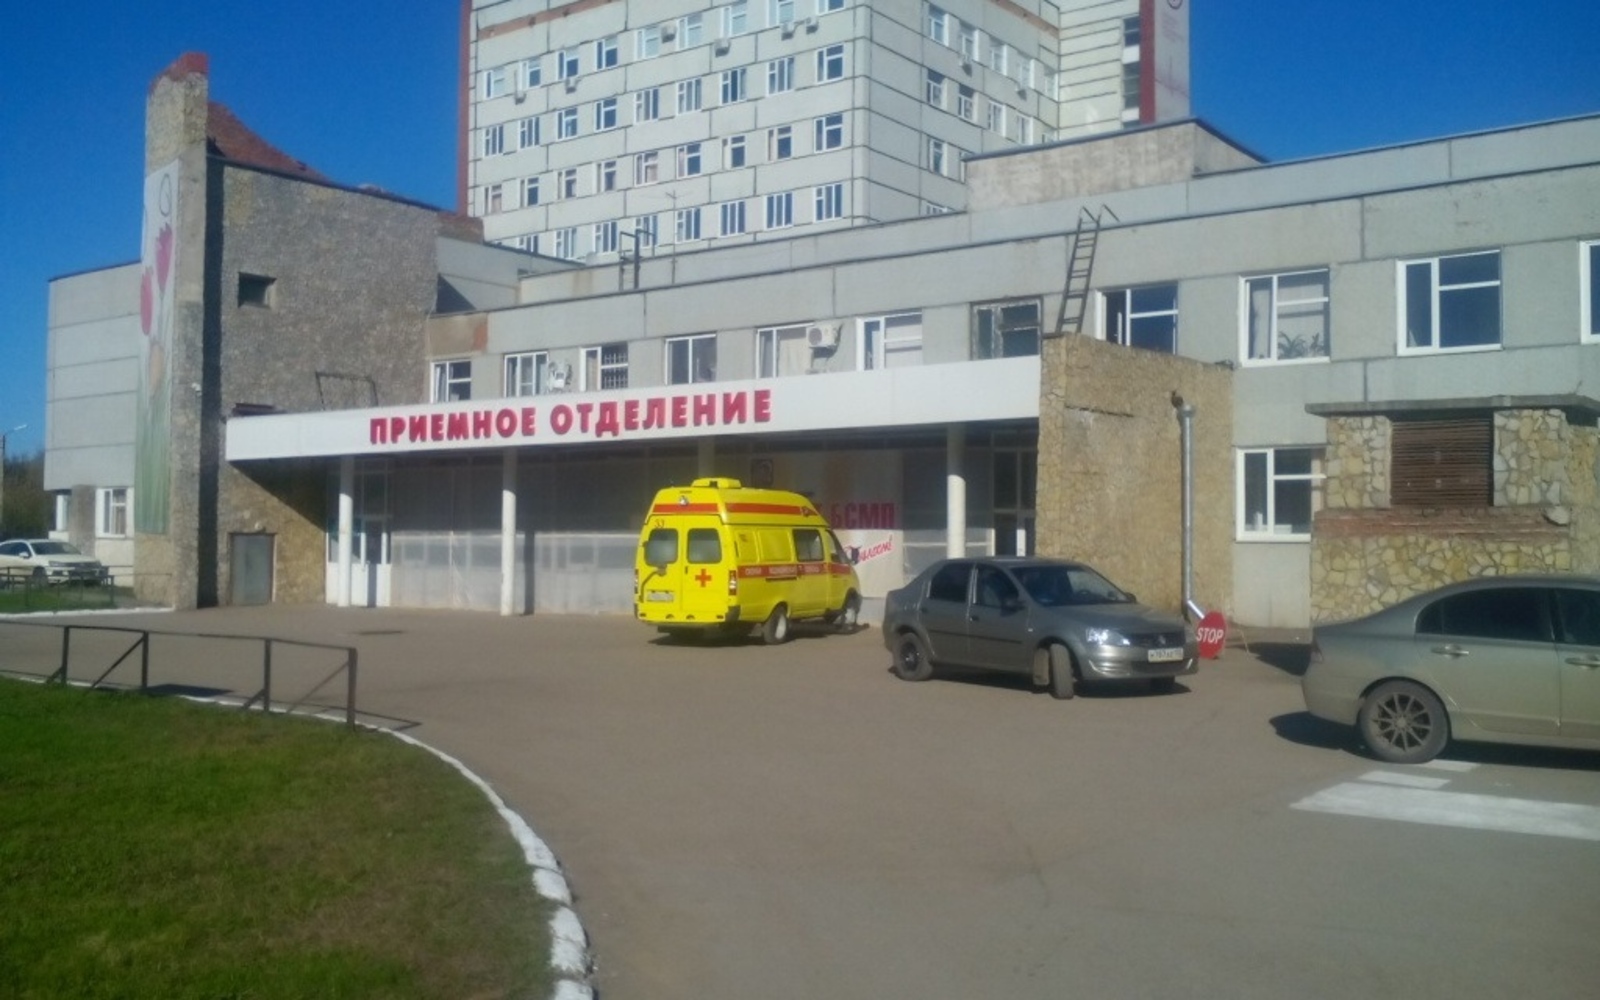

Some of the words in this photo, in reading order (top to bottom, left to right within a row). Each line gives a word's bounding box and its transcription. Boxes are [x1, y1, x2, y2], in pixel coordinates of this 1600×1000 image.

[369, 407, 536, 445] ПРИЕМНОЕ
[549, 390, 772, 438] ОТДЕЛЕНИЕ
[830, 502, 895, 530] БСМП
[1196, 627, 1224, 644] STOP
